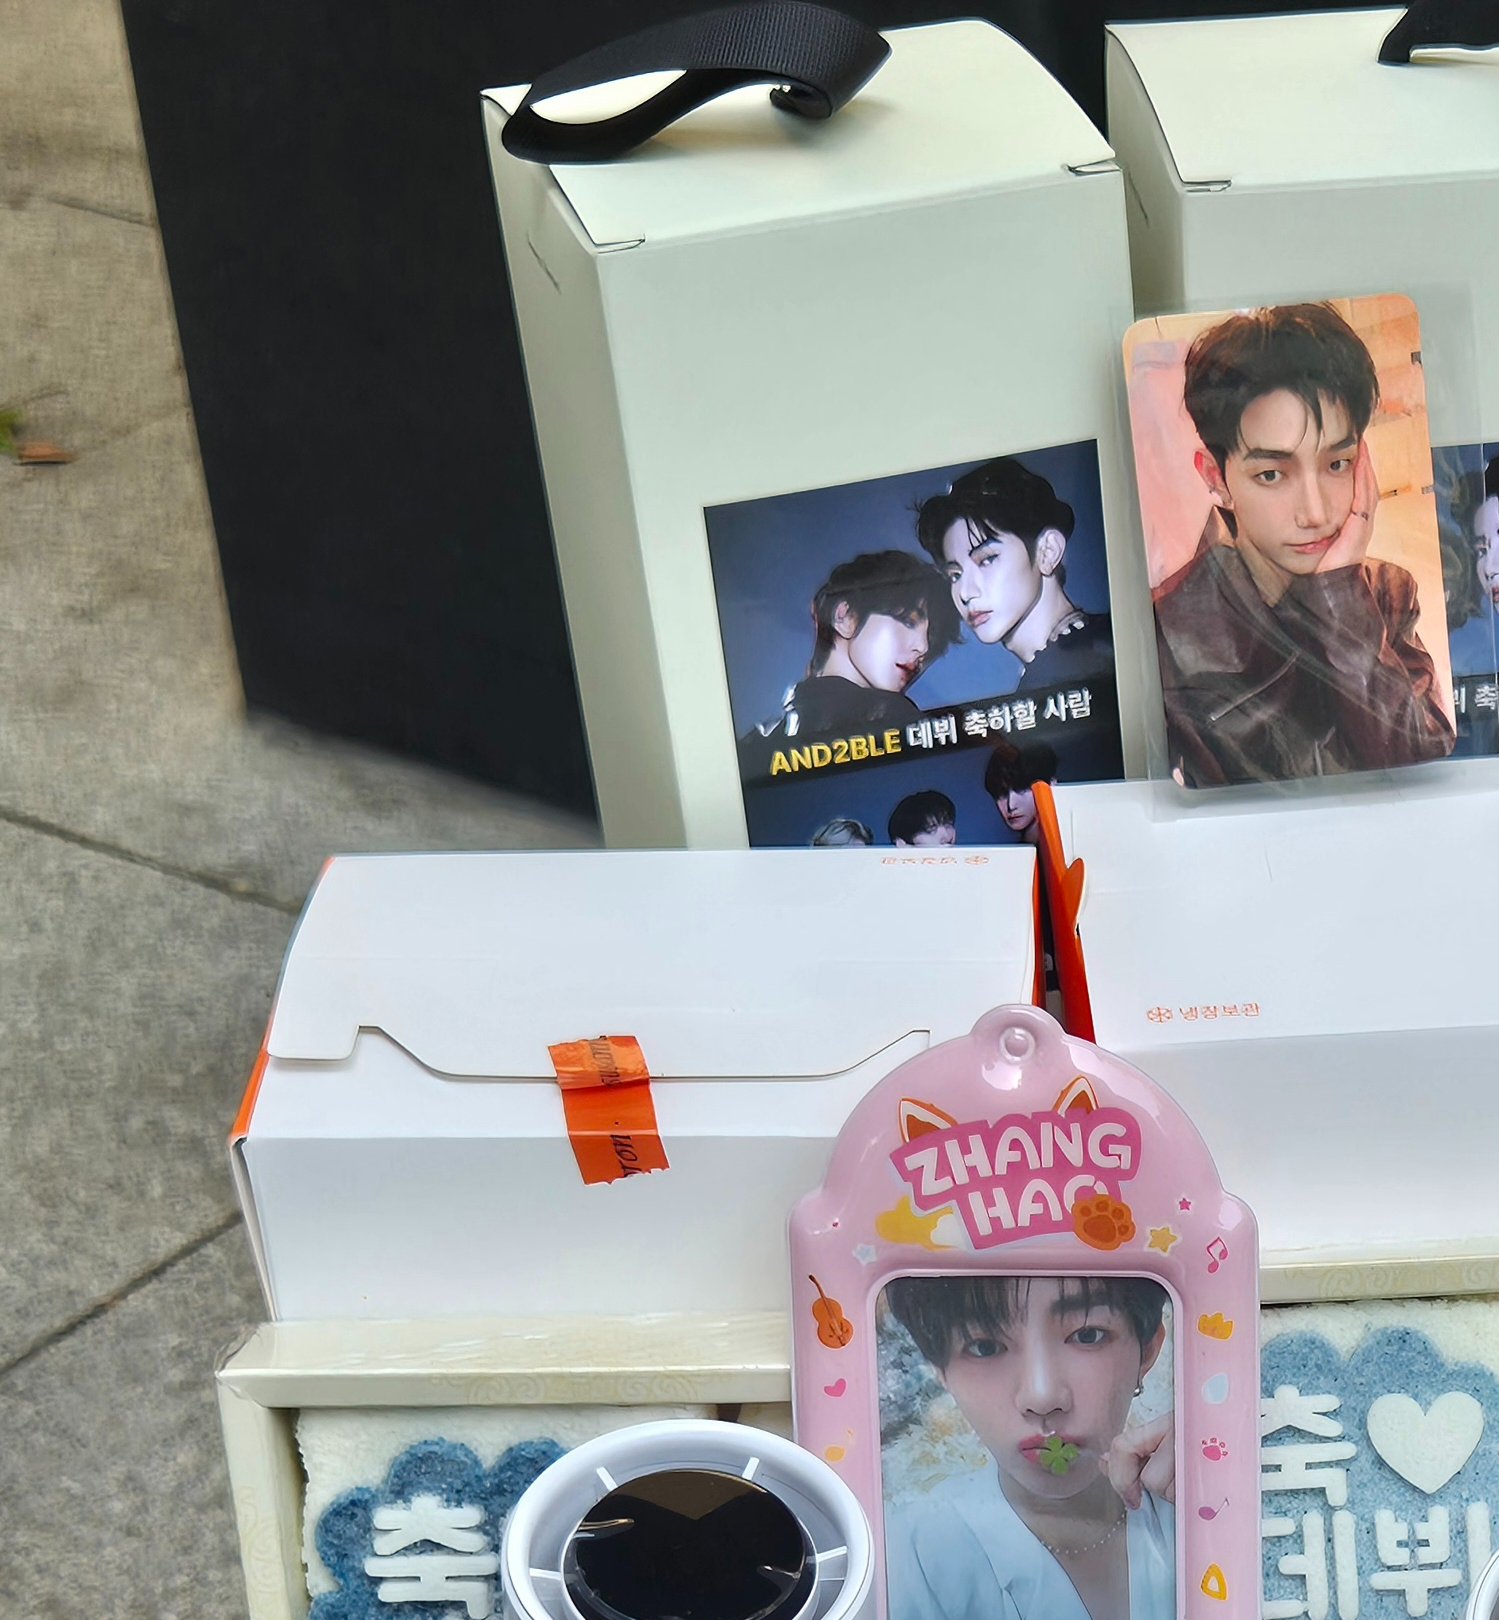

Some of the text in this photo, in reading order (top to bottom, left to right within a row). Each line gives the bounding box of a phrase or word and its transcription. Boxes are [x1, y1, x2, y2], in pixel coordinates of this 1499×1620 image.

[769, 687, 1093, 776] AND2BLE 데뷔 축하할 사람
[1179, 1002, 1261, 1022] 냉장보관
[904, 1121, 1132, 1196] ZHANG
[363, 1492, 500, 1620] 축
